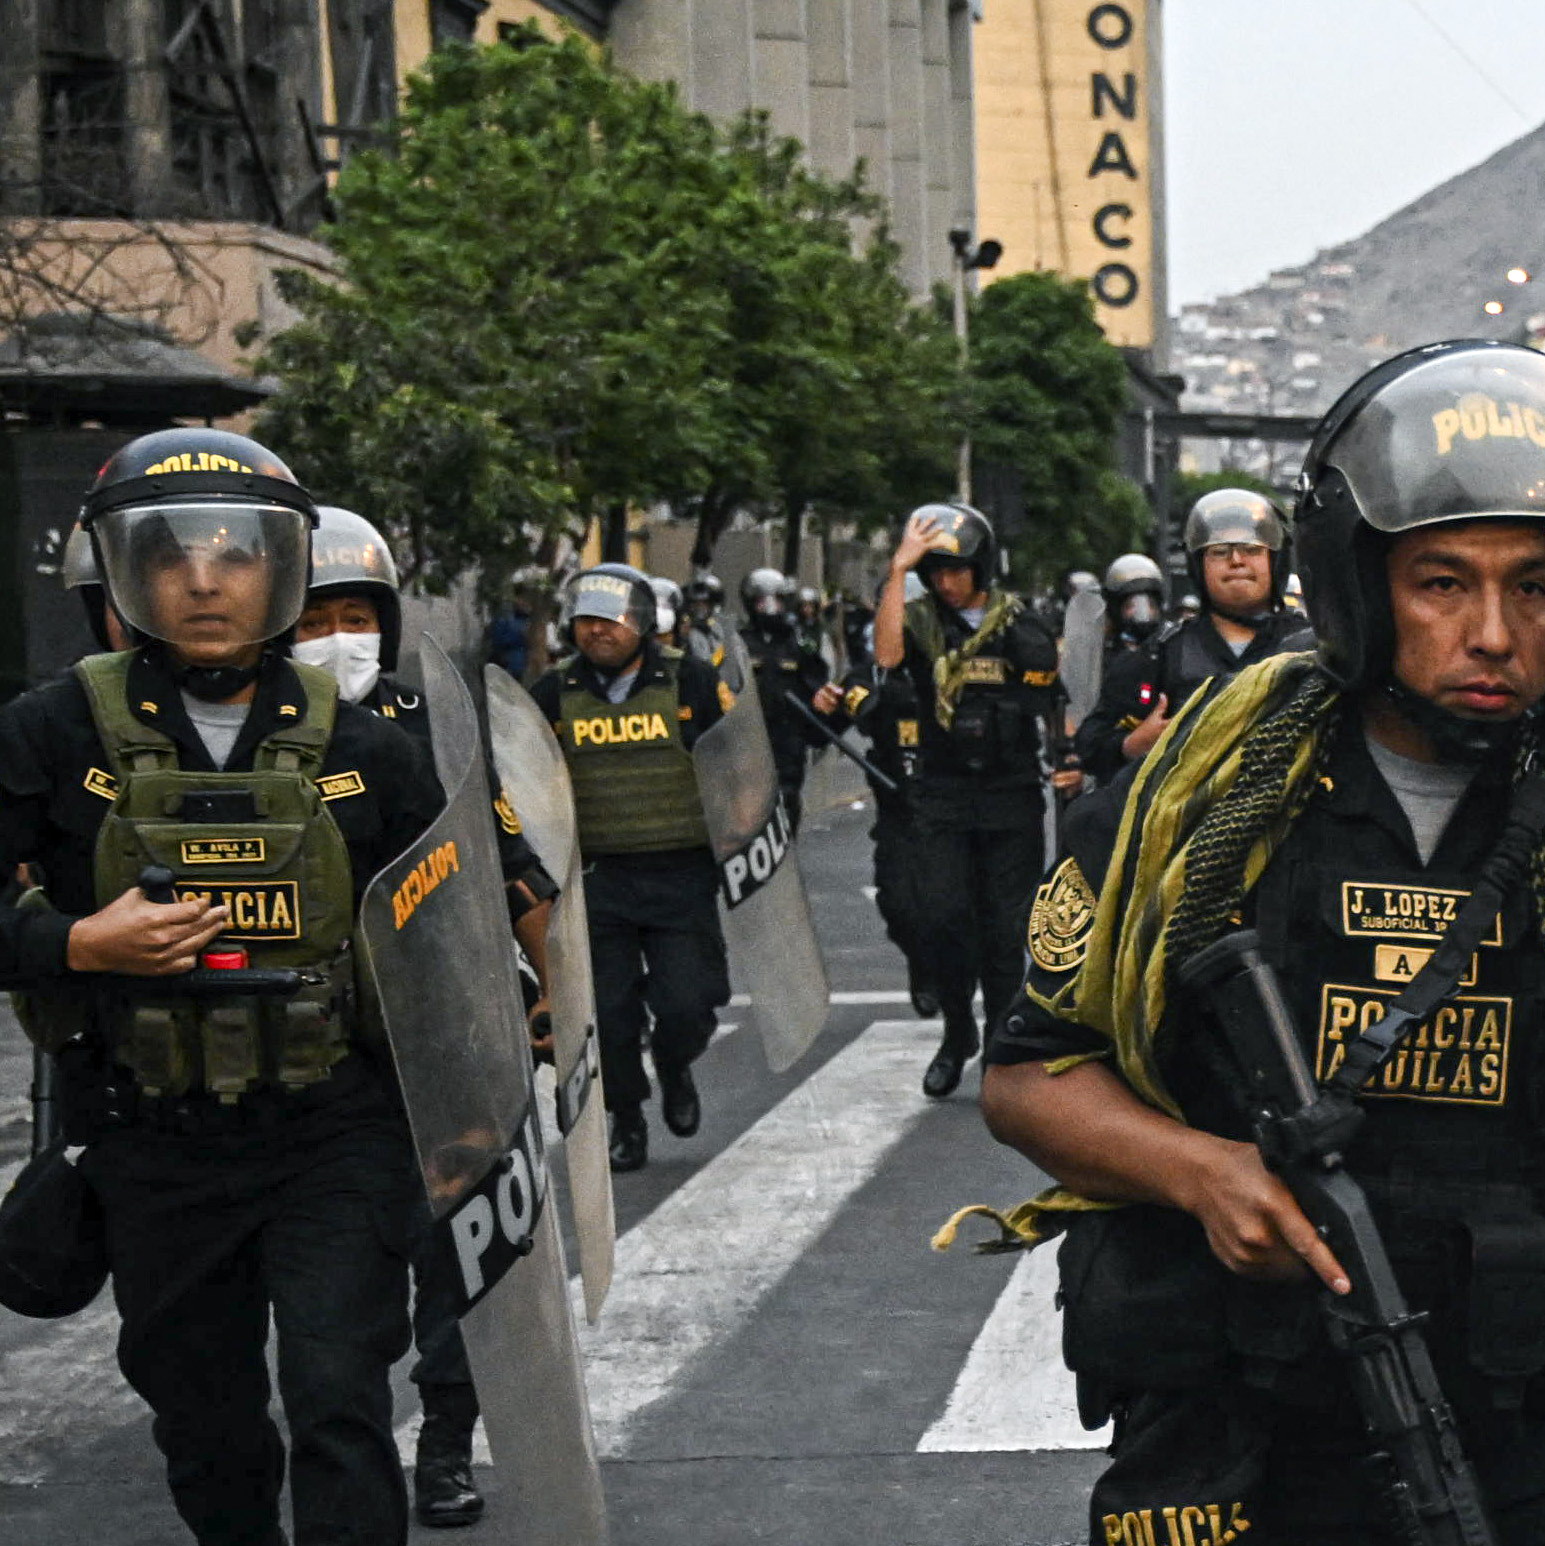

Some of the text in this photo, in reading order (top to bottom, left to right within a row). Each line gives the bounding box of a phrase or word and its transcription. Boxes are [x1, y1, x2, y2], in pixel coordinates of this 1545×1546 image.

[573, 713, 669, 746] POLICIA
[182, 891, 292, 930] ICIA
[1351, 890, 1456, 920] J. LOPEZ
[1361, 915, 1428, 930] SUBOFICIAL
[1392, 953, 1413, 976] A
[1328, 997, 1501, 1049] POICIA
[1326, 1043, 1499, 1094] AUILAS
